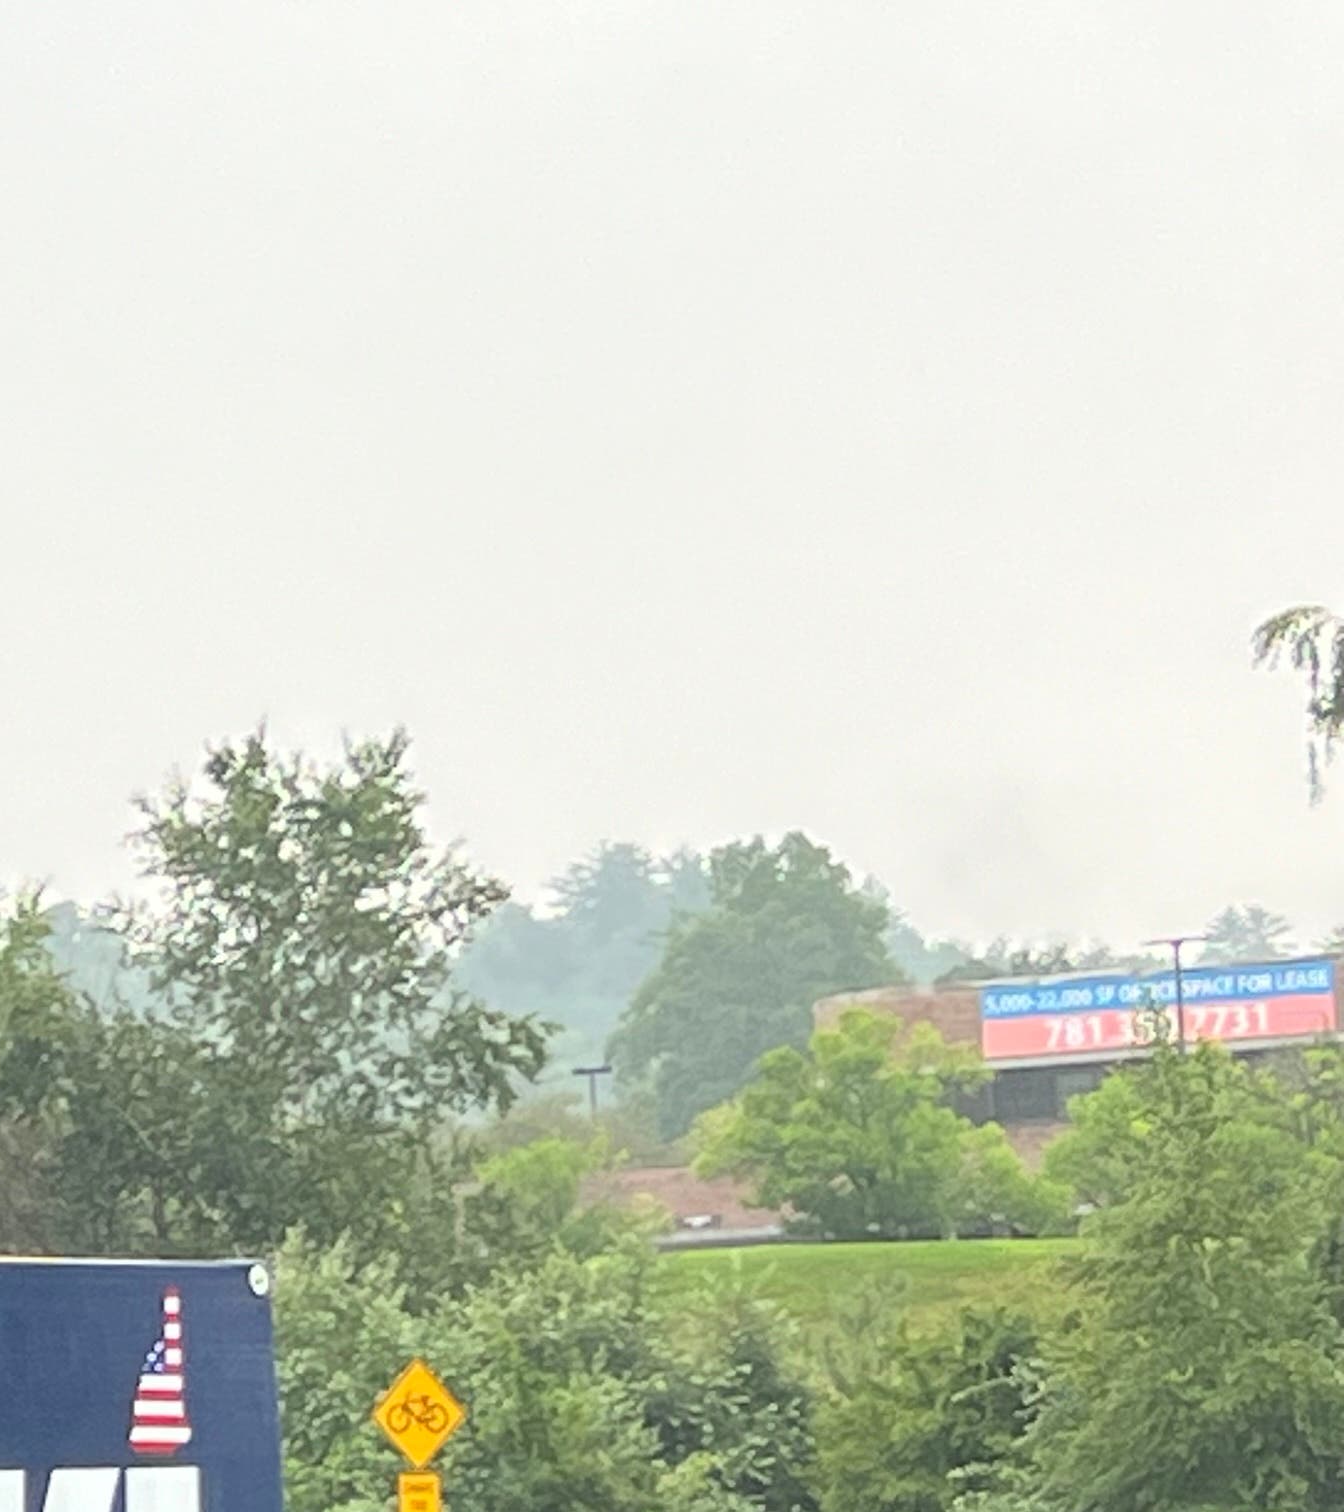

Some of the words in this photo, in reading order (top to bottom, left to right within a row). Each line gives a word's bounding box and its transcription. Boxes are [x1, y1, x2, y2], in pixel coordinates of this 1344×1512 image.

[1181, 975, 1233, 998] SPACE
[1237, 971, 1272, 994] FOR
[1276, 967, 1329, 991] LEASE
[1044, 1015, 1104, 1049] 781
[1190, 1002, 1268, 1040] 7731
